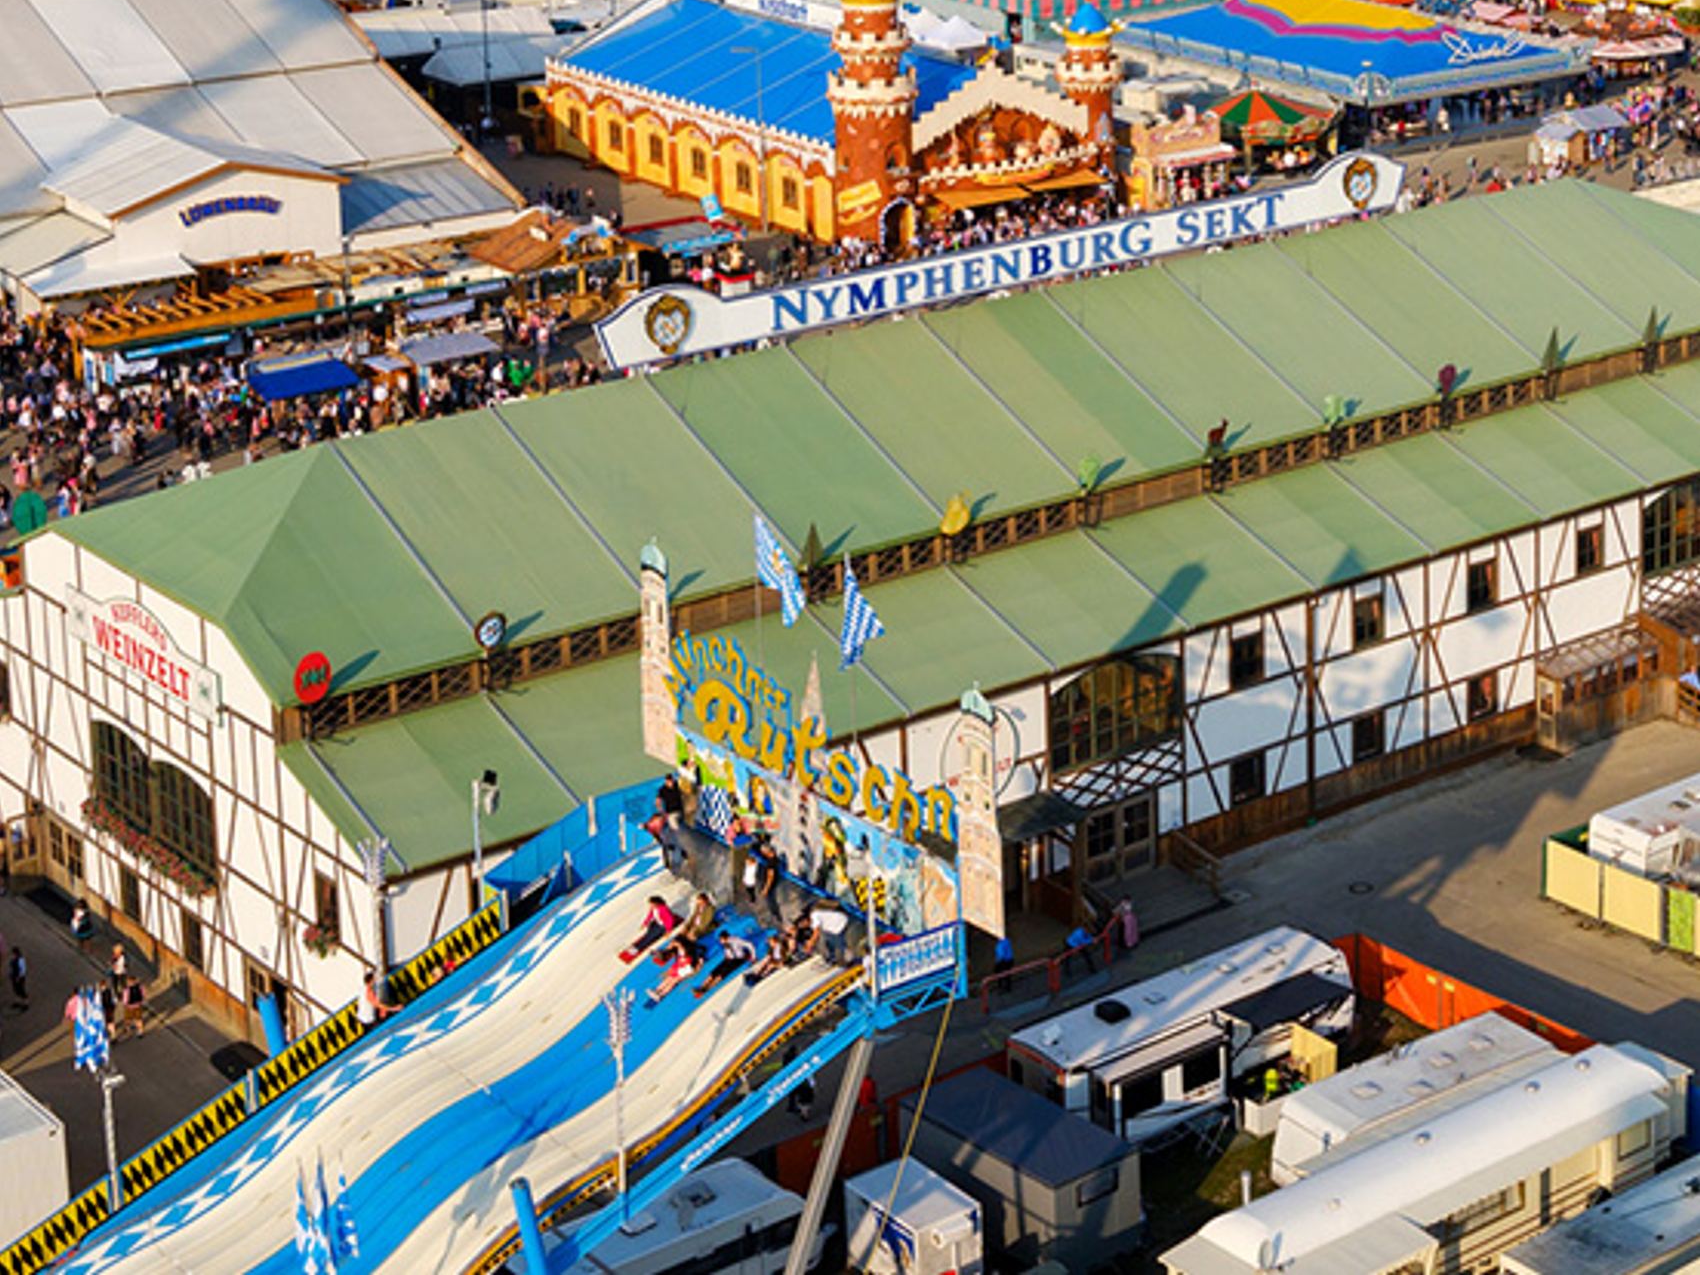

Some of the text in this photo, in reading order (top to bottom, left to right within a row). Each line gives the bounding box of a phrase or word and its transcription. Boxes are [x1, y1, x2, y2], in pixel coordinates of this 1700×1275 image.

[774, 194, 1284, 330] NYMPHENBURG SEKT
[92, 614, 189, 701] WEINZELT
